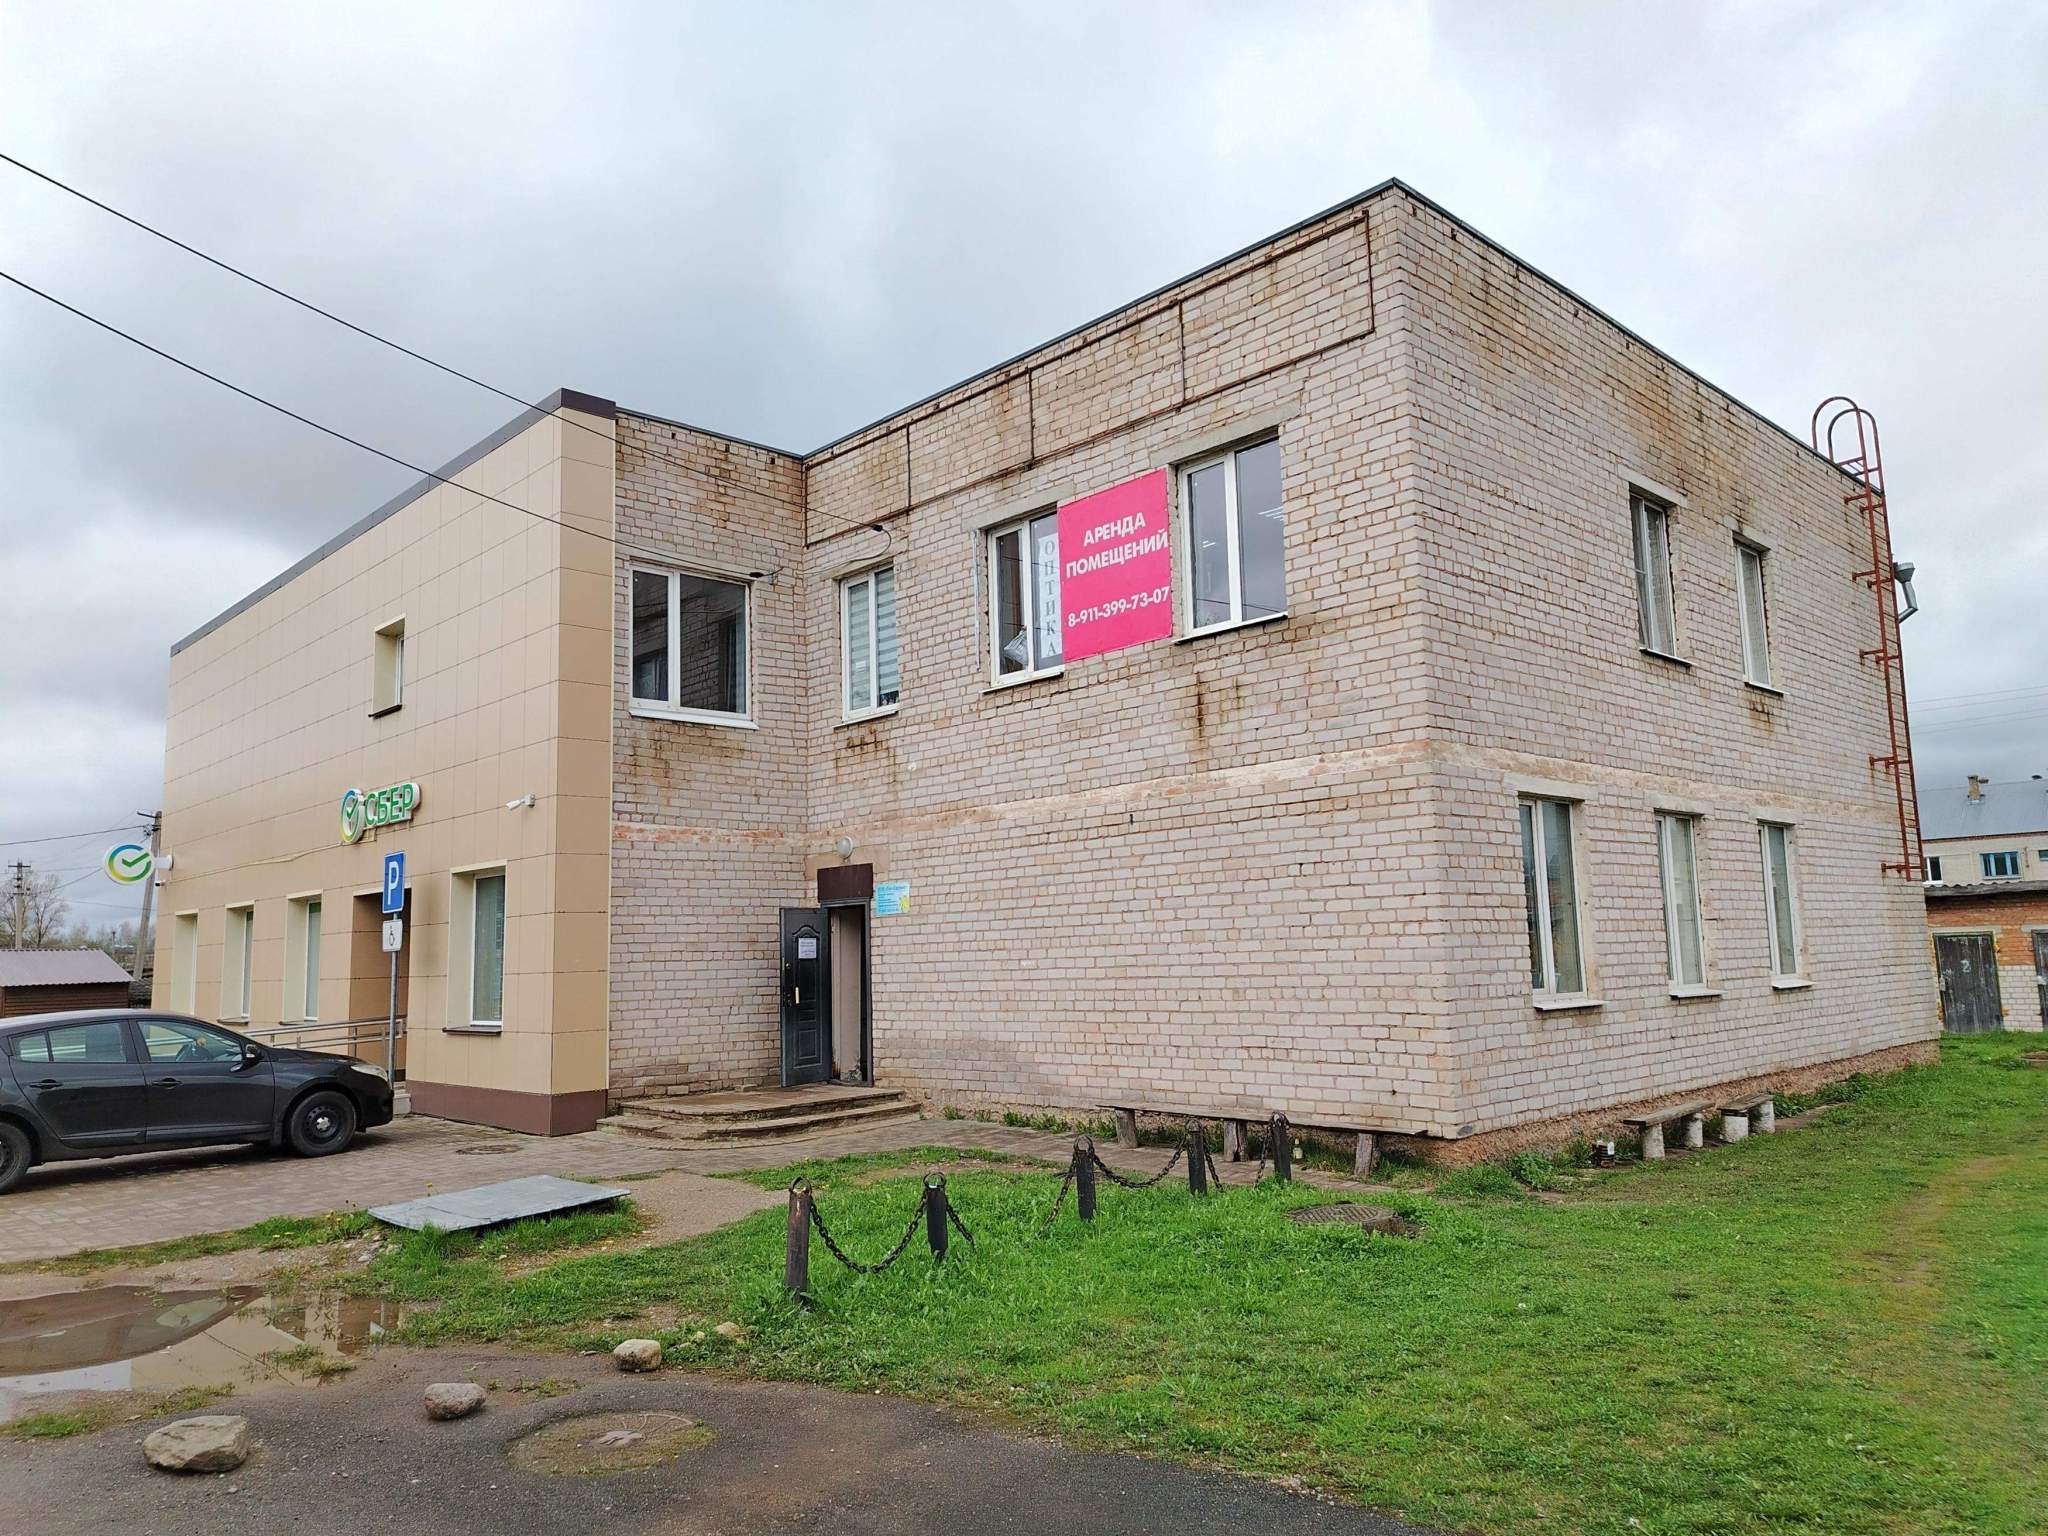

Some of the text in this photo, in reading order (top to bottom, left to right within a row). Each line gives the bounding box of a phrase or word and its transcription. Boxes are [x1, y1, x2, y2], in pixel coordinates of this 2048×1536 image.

[1083, 512, 1146, 546] АРЕНДА
[1066, 528, 1168, 578] ПОМЕЩЕНИЙ
[1044, 541, 1057, 656] ОПТИКА
[1068, 586, 1170, 627] 8-911-399-73-07
[365, 783, 416, 826] СБЕР
[387, 861, 399, 905] P
